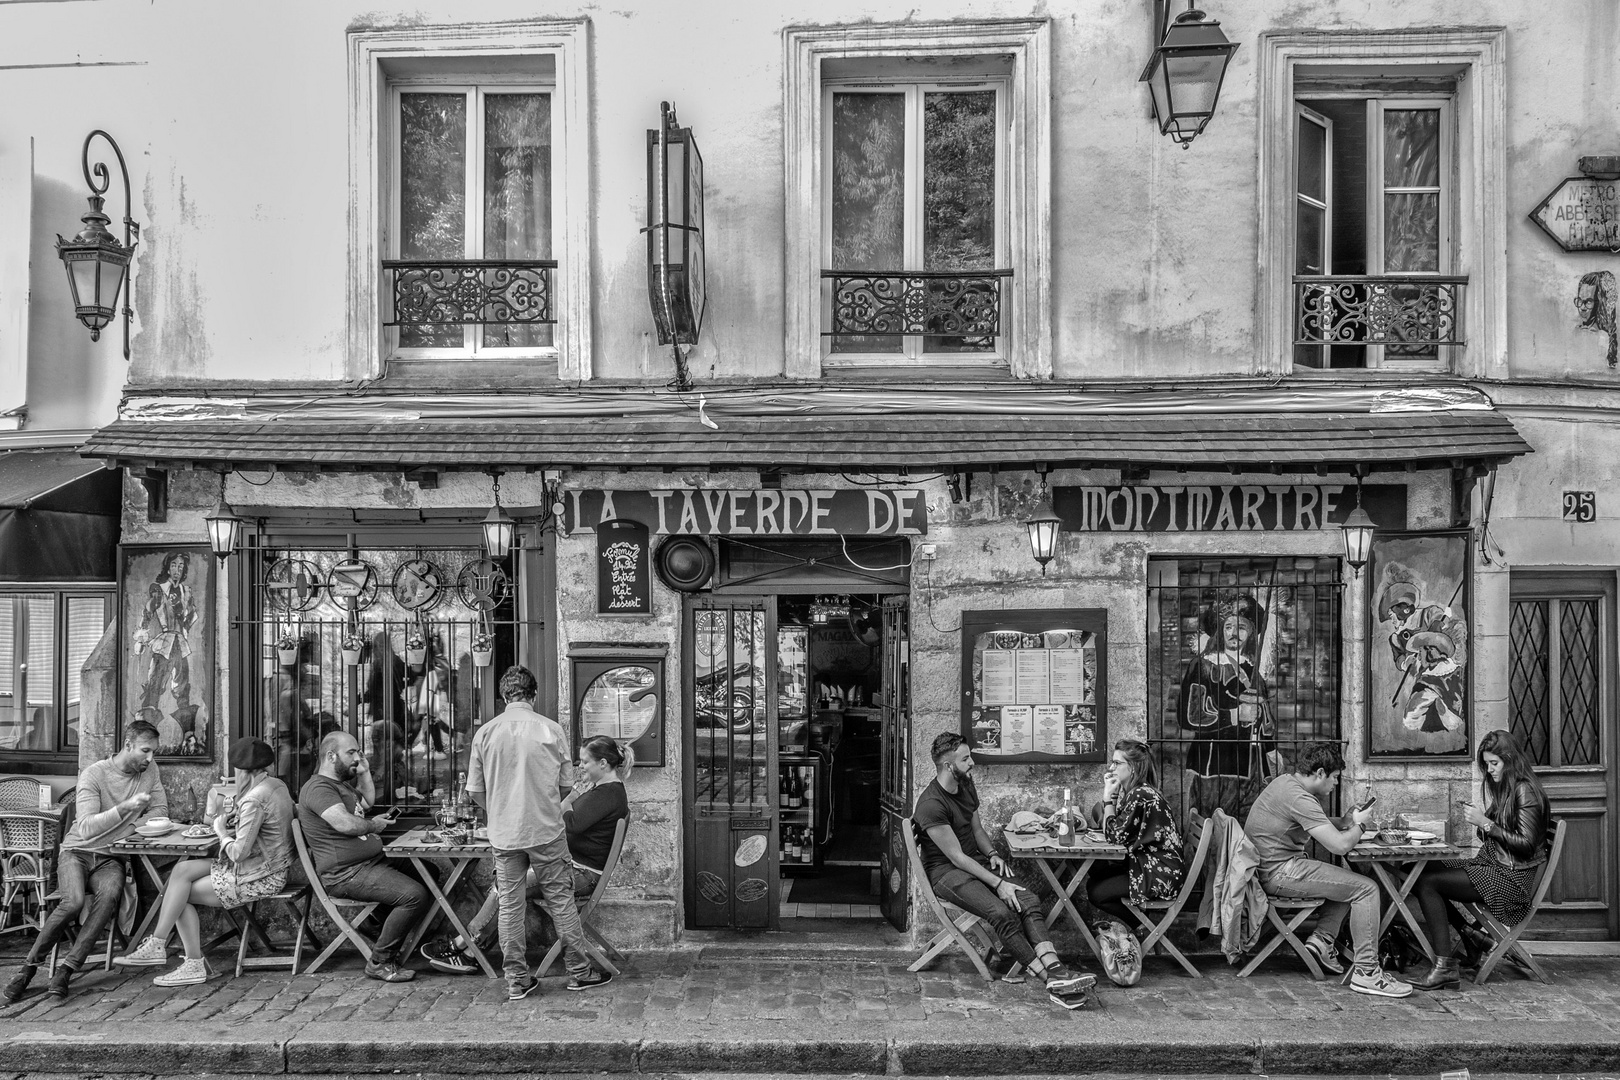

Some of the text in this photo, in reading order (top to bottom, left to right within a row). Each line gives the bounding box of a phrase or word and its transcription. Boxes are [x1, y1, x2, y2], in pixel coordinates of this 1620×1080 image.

[570, 490, 922, 534] LA TAVERNE DE
[1080, 486, 1344, 531] MONTMARTRE
[1563, 494, 1594, 521] 25
[602, 547, 640, 563] Formule
[1375, 979, 1389, 990] N
